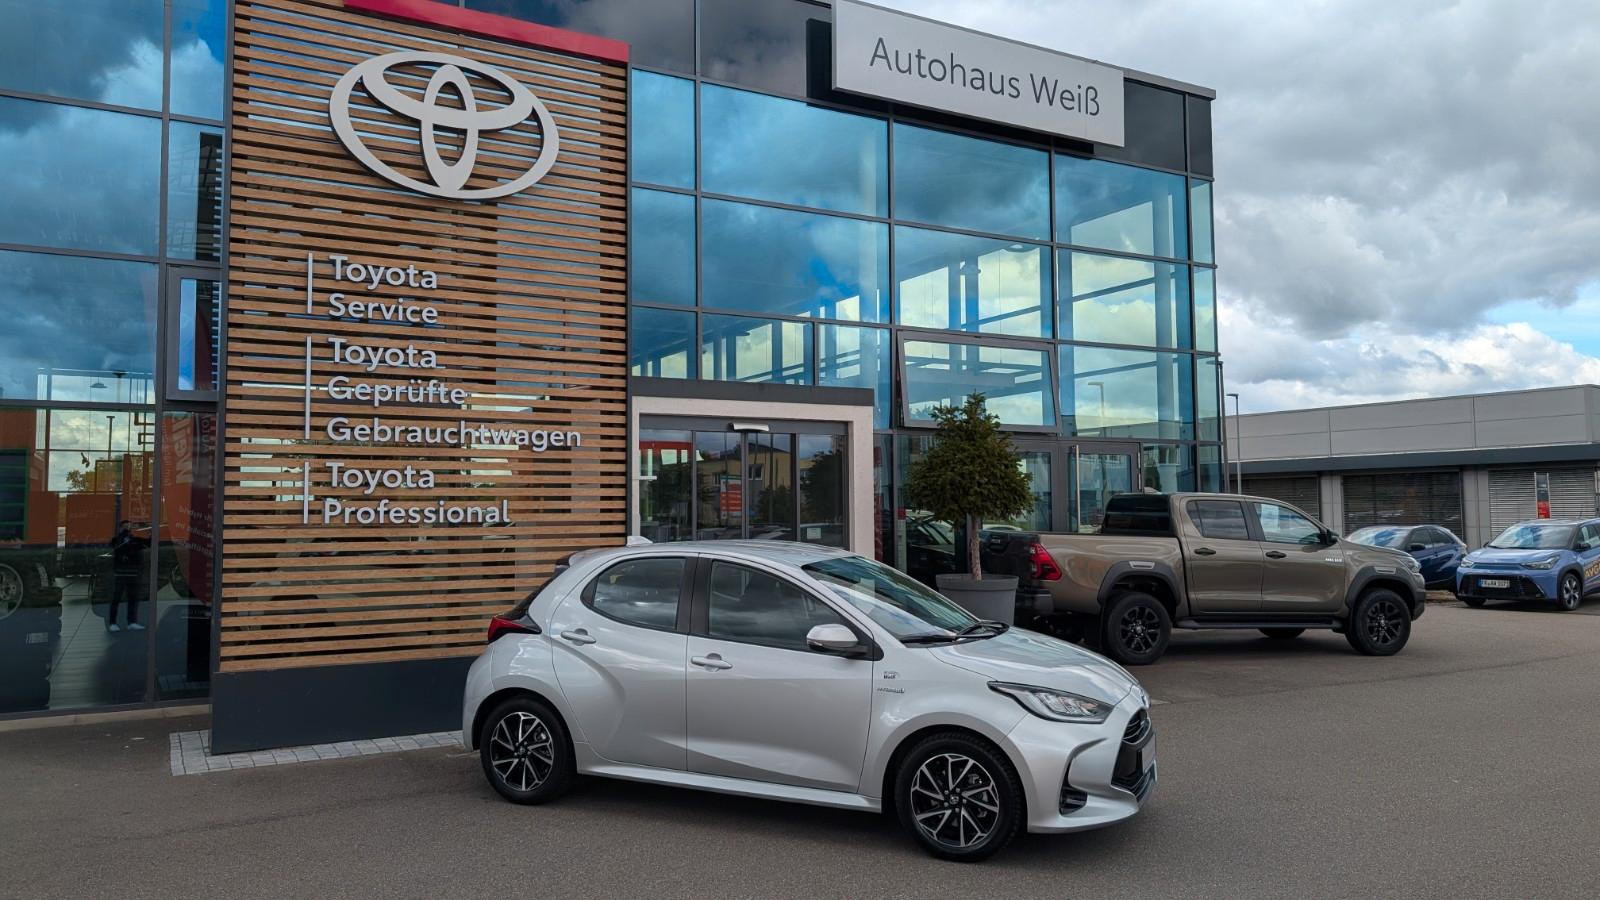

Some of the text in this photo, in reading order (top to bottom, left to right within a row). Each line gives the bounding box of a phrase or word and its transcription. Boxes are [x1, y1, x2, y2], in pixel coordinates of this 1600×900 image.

[869, 36, 1101, 116] Autohaus Weiß
[328, 254, 438, 290] Toyota
[328, 292, 439, 324] Service
[327, 337, 438, 372] Toyota
[327, 375, 467, 408] Geprüfte
[326, 416, 582, 452] Gebrauchtwagen
[325, 461, 436, 494] Toyota
[323, 498, 511, 525] Professional
